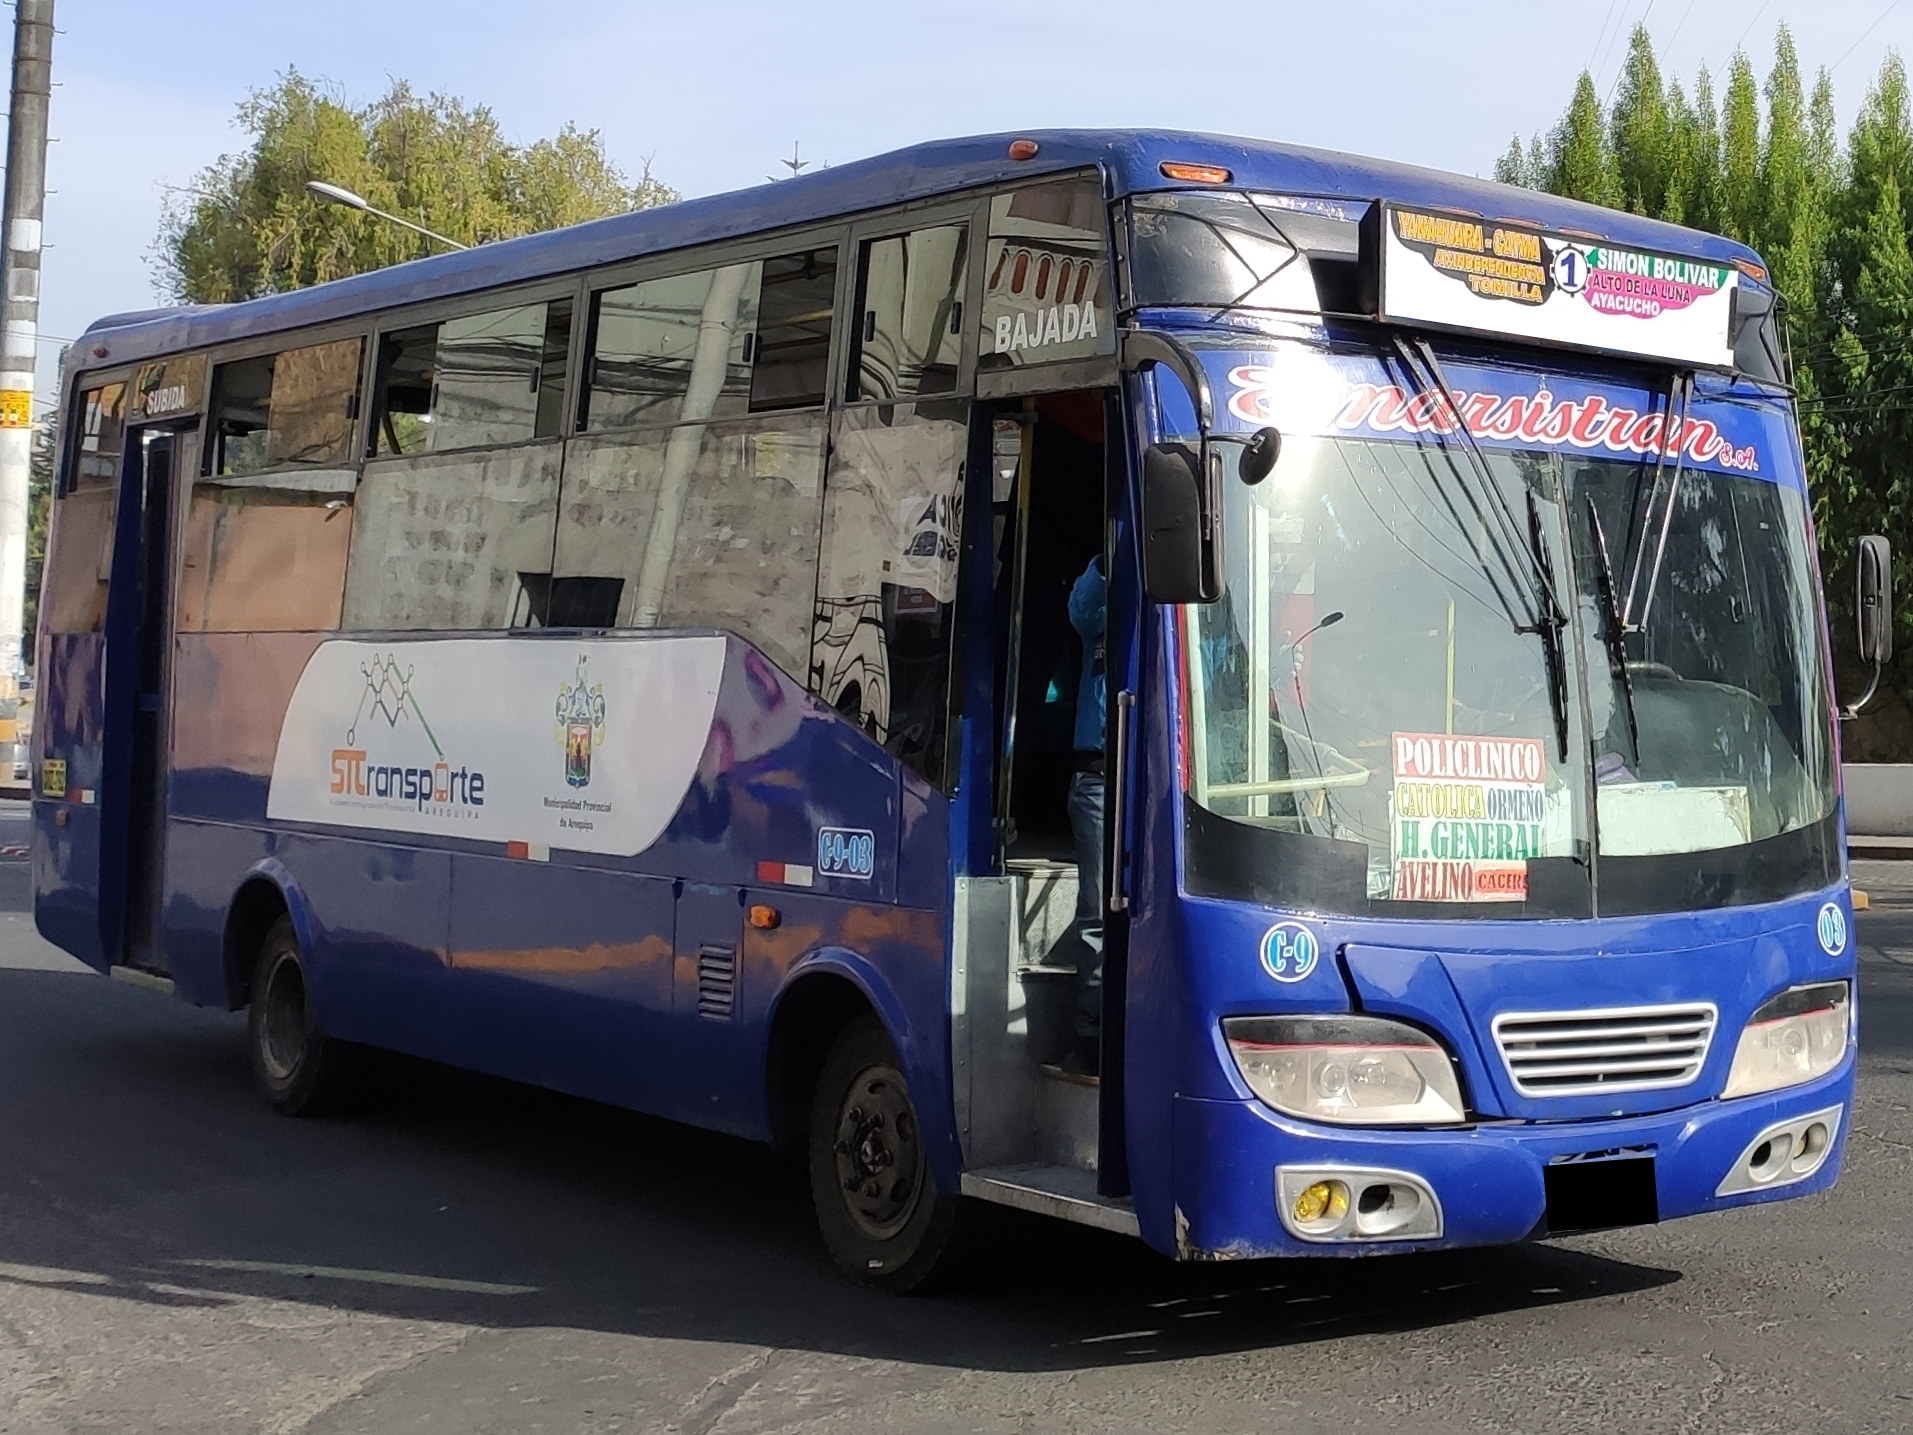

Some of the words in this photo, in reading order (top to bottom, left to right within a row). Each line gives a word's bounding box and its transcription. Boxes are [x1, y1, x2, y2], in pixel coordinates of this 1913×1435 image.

[1398, 211, 1484, 252] YANAHUARA
[1493, 229, 1541, 263] CAYMA
[1561, 252, 1578, 287] 1
[1597, 248, 1650, 278] SIMON
[1653, 257, 1719, 289] BOLIVAR
[1469, 274, 1543, 303] TOMILLA
[1591, 291, 1661, 317] AYACUCHO
[1593, 274, 1622, 290] ALTO
[1626, 277, 1641, 294] DE
[1644, 280, 1658, 298] LA
[1661, 282, 1691, 304] LUNA
[995, 300, 1098, 354] BAJADA
[146, 384, 185, 415] SUBIDA
[1395, 737, 1541, 781] POLICLINICO
[1396, 783, 1487, 820] CATOLICA
[1487, 783, 1544, 822] ORMEÑO
[820, 832, 872, 874] C-9-03
[1396, 861, 1473, 900] AVELINO
[1821, 909, 1843, 948] 03
[1267, 930, 1313, 973] C-9
